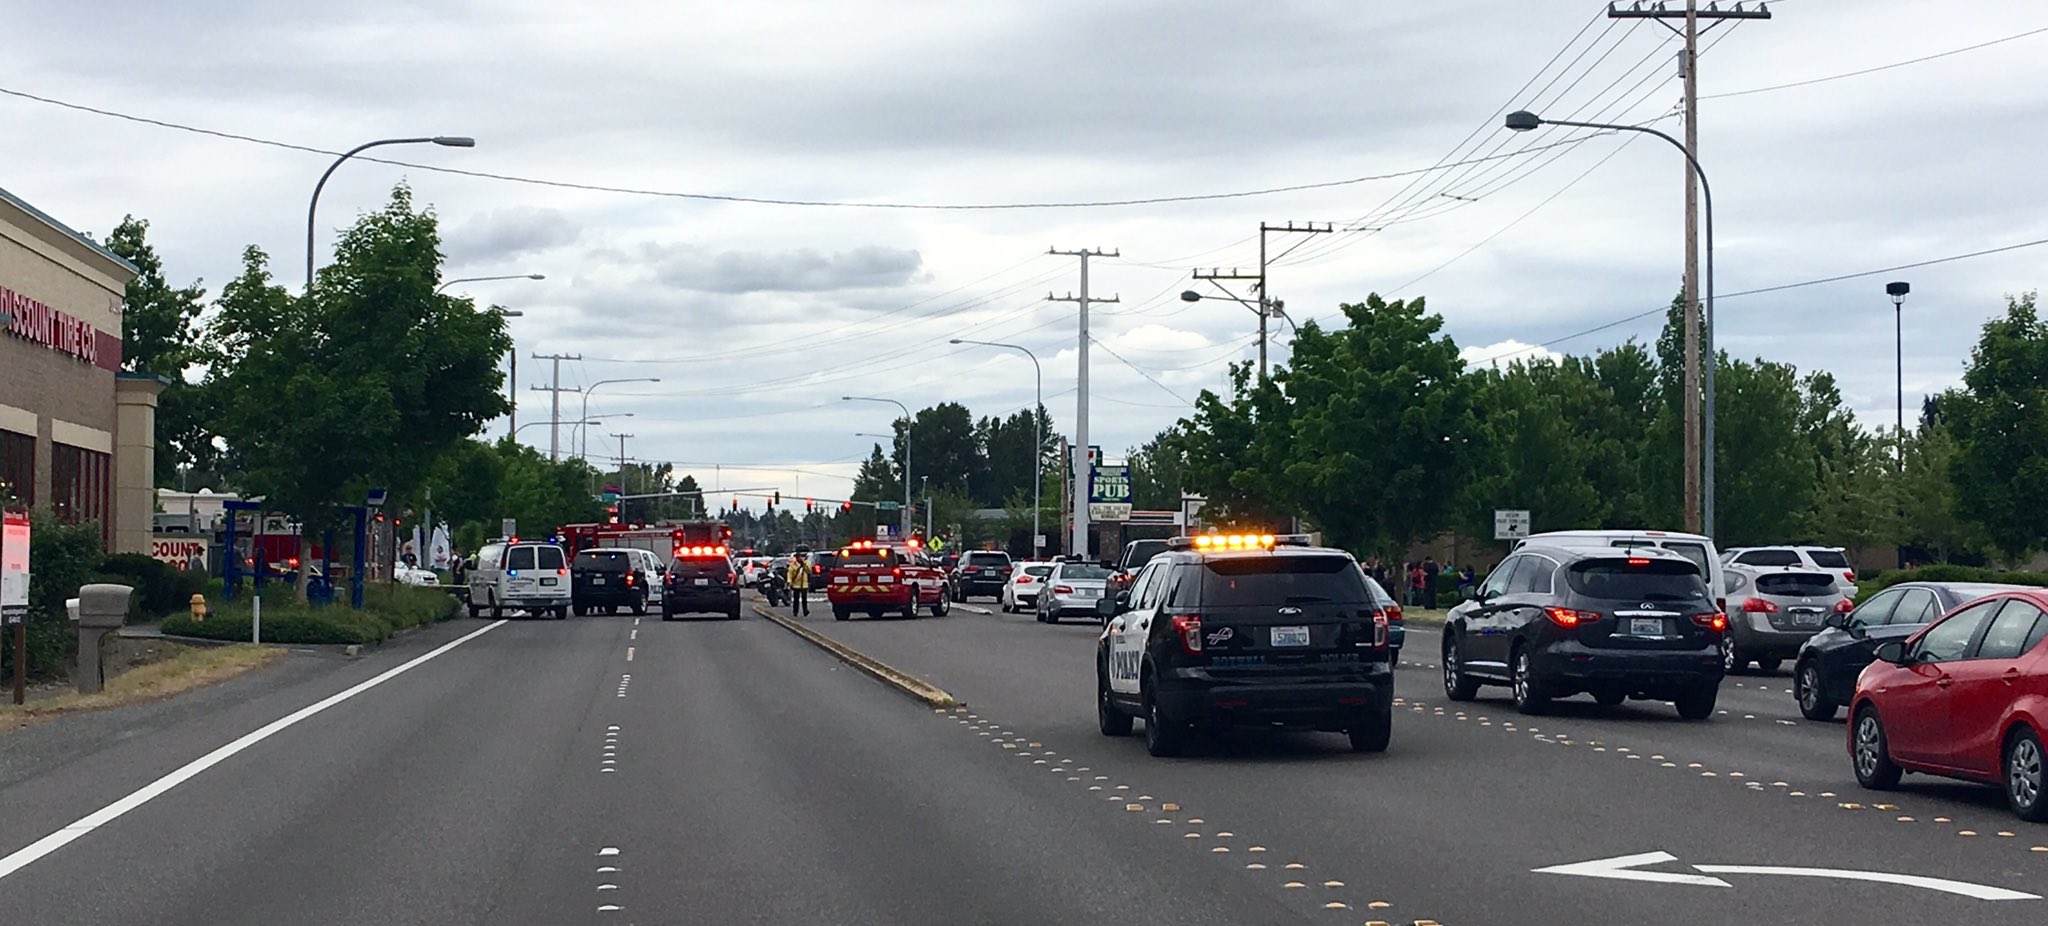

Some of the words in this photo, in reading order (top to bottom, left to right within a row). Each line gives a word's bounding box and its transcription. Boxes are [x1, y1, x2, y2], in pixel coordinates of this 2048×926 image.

[0, 286, 56, 349] DISCOUNT
[58, 311, 80, 355] TIRE
[1094, 476, 1129, 484] SPORTS
[1092, 483, 1130, 498] PUB
